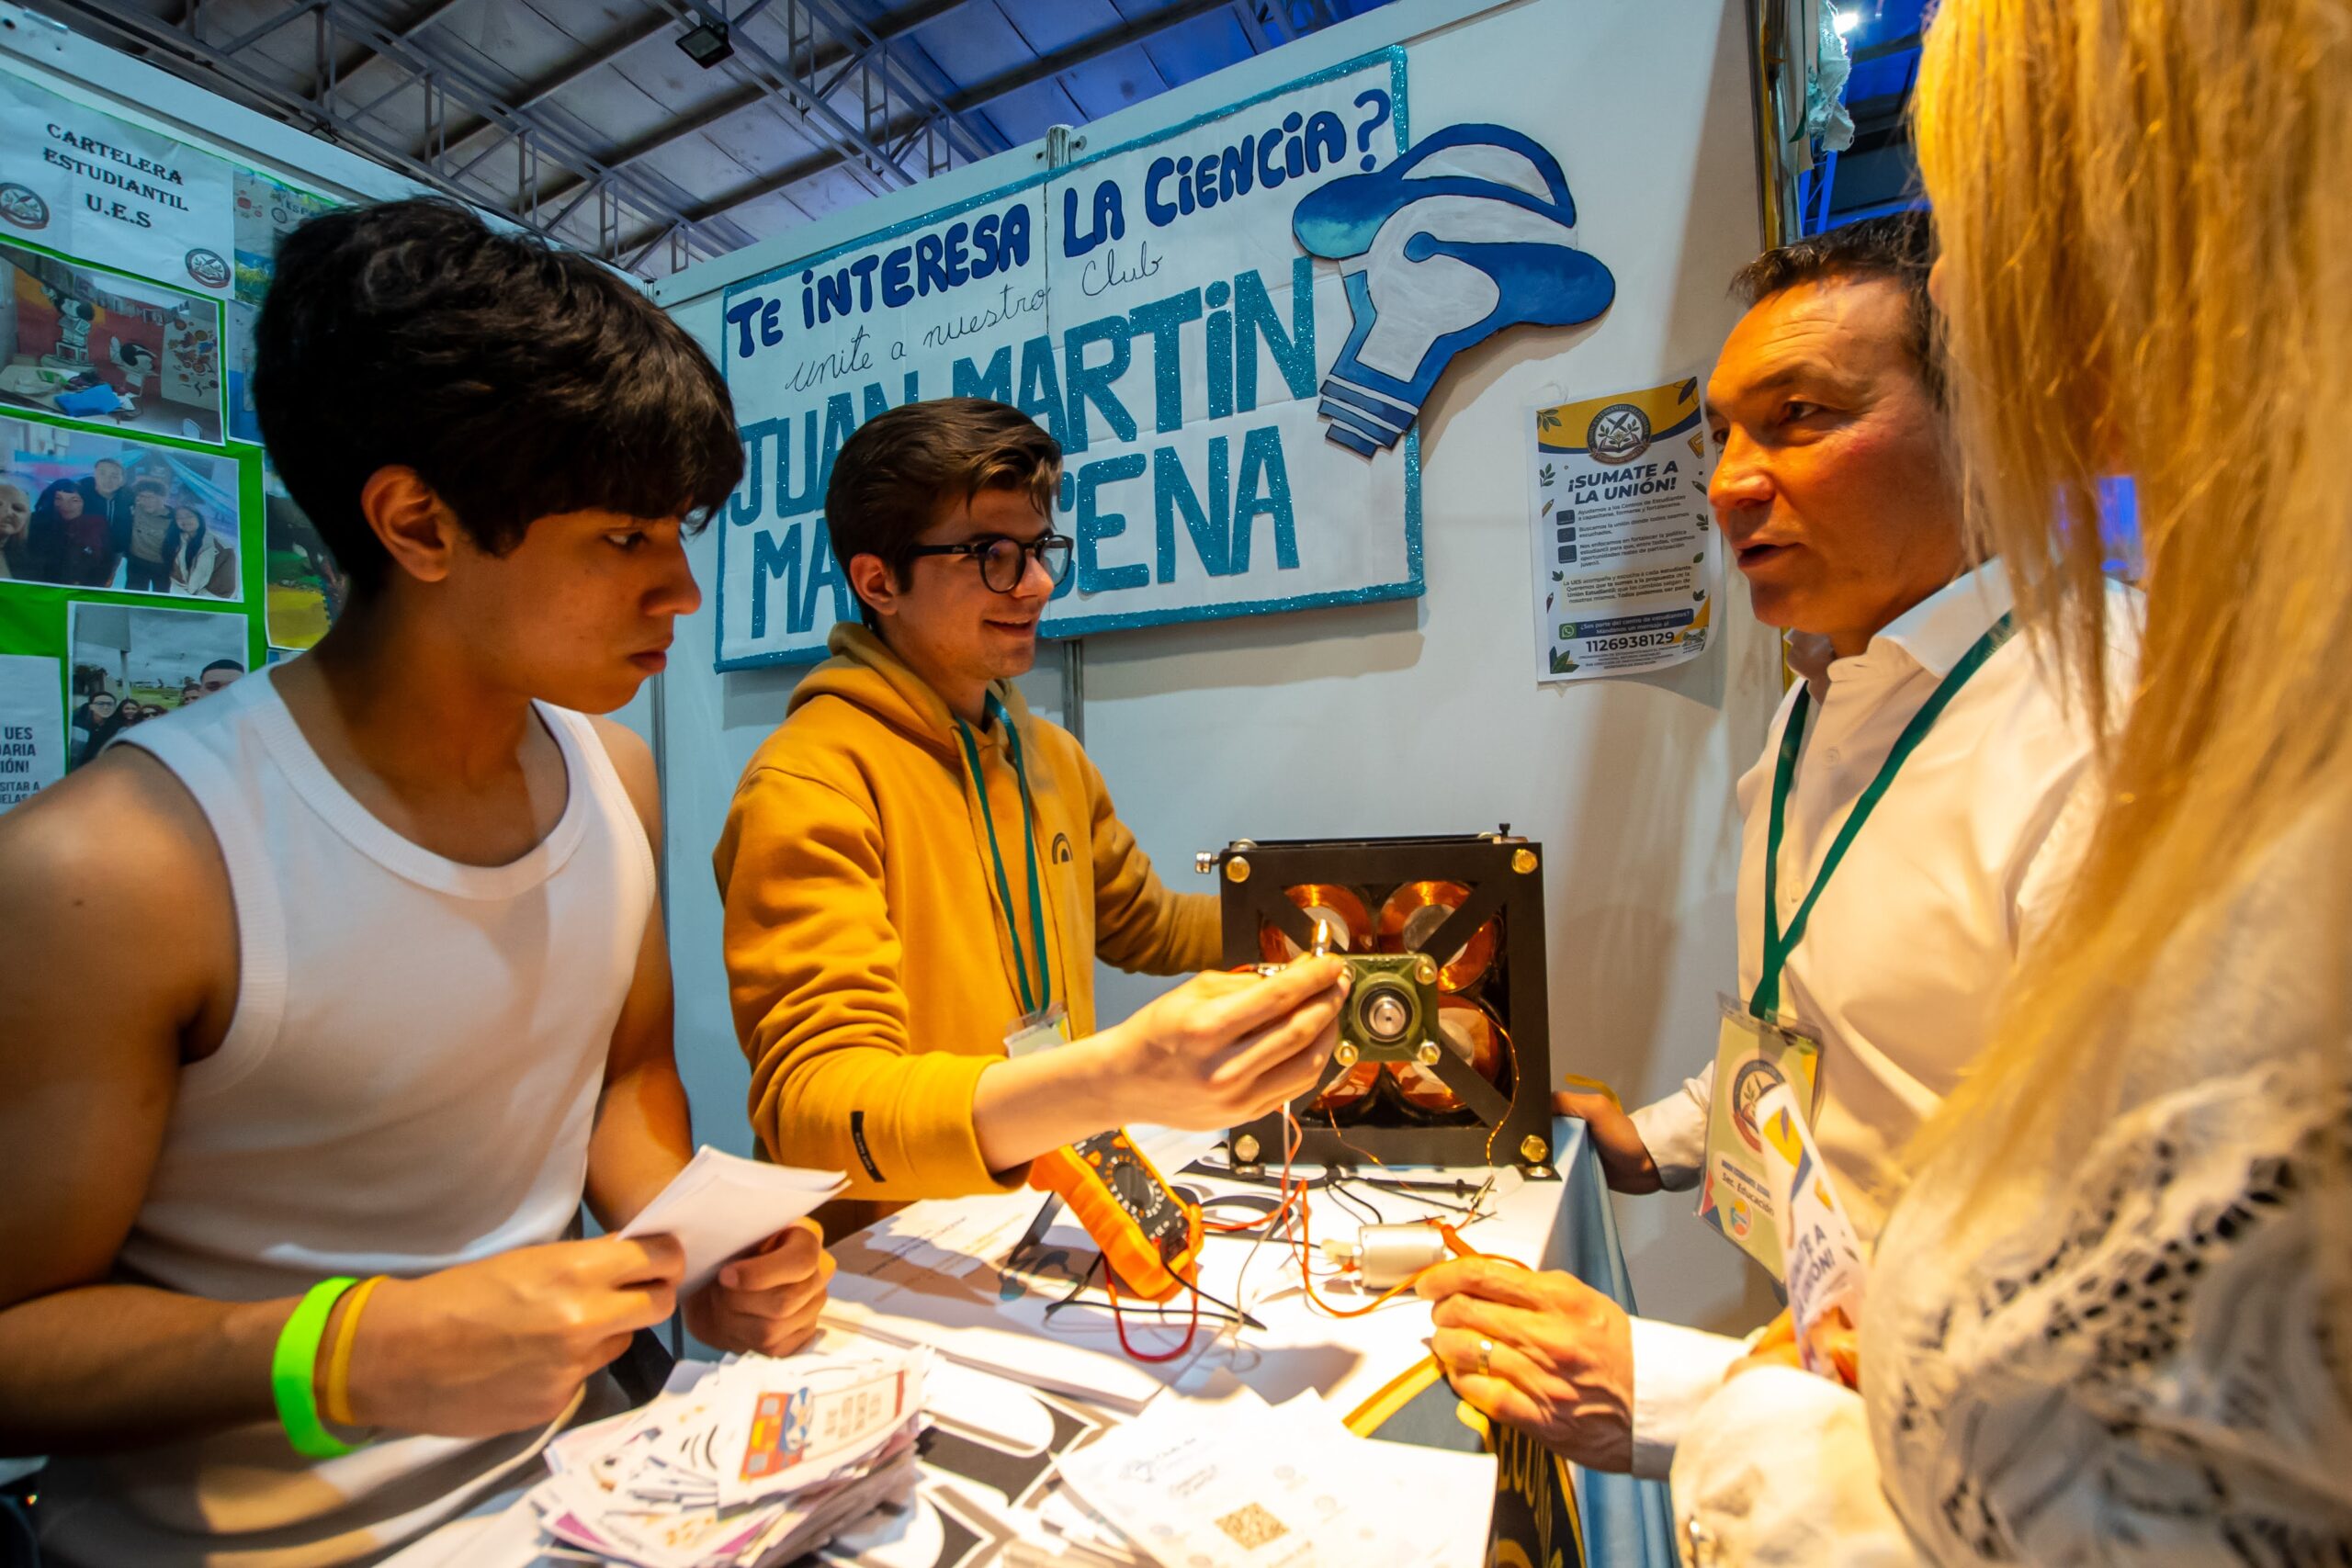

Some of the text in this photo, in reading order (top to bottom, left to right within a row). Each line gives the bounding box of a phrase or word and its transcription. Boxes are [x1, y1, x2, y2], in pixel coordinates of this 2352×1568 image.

[47, 123, 184, 185] CARTELERA
[43, 147, 188, 211] ESTUDIANTIL
[85, 193, 152, 228] U.E.S
[727, 297, 783, 358] TE
[1063, 180, 1125, 257] LA
[891, 341, 907, 360] a
[922, 284, 1051, 348] nuestro
[1082, 241, 1163, 297] Club
[730, 370, 919, 526] JUA
[1567, 461, 1679, 492] ¡SUMATE A
[1575, 477, 1677, 505] LA UNIÓN!
[1586, 631, 1674, 652] 1126938129
[0, 743, 36, 756] ARIA
[5, 727, 33, 740] UES
